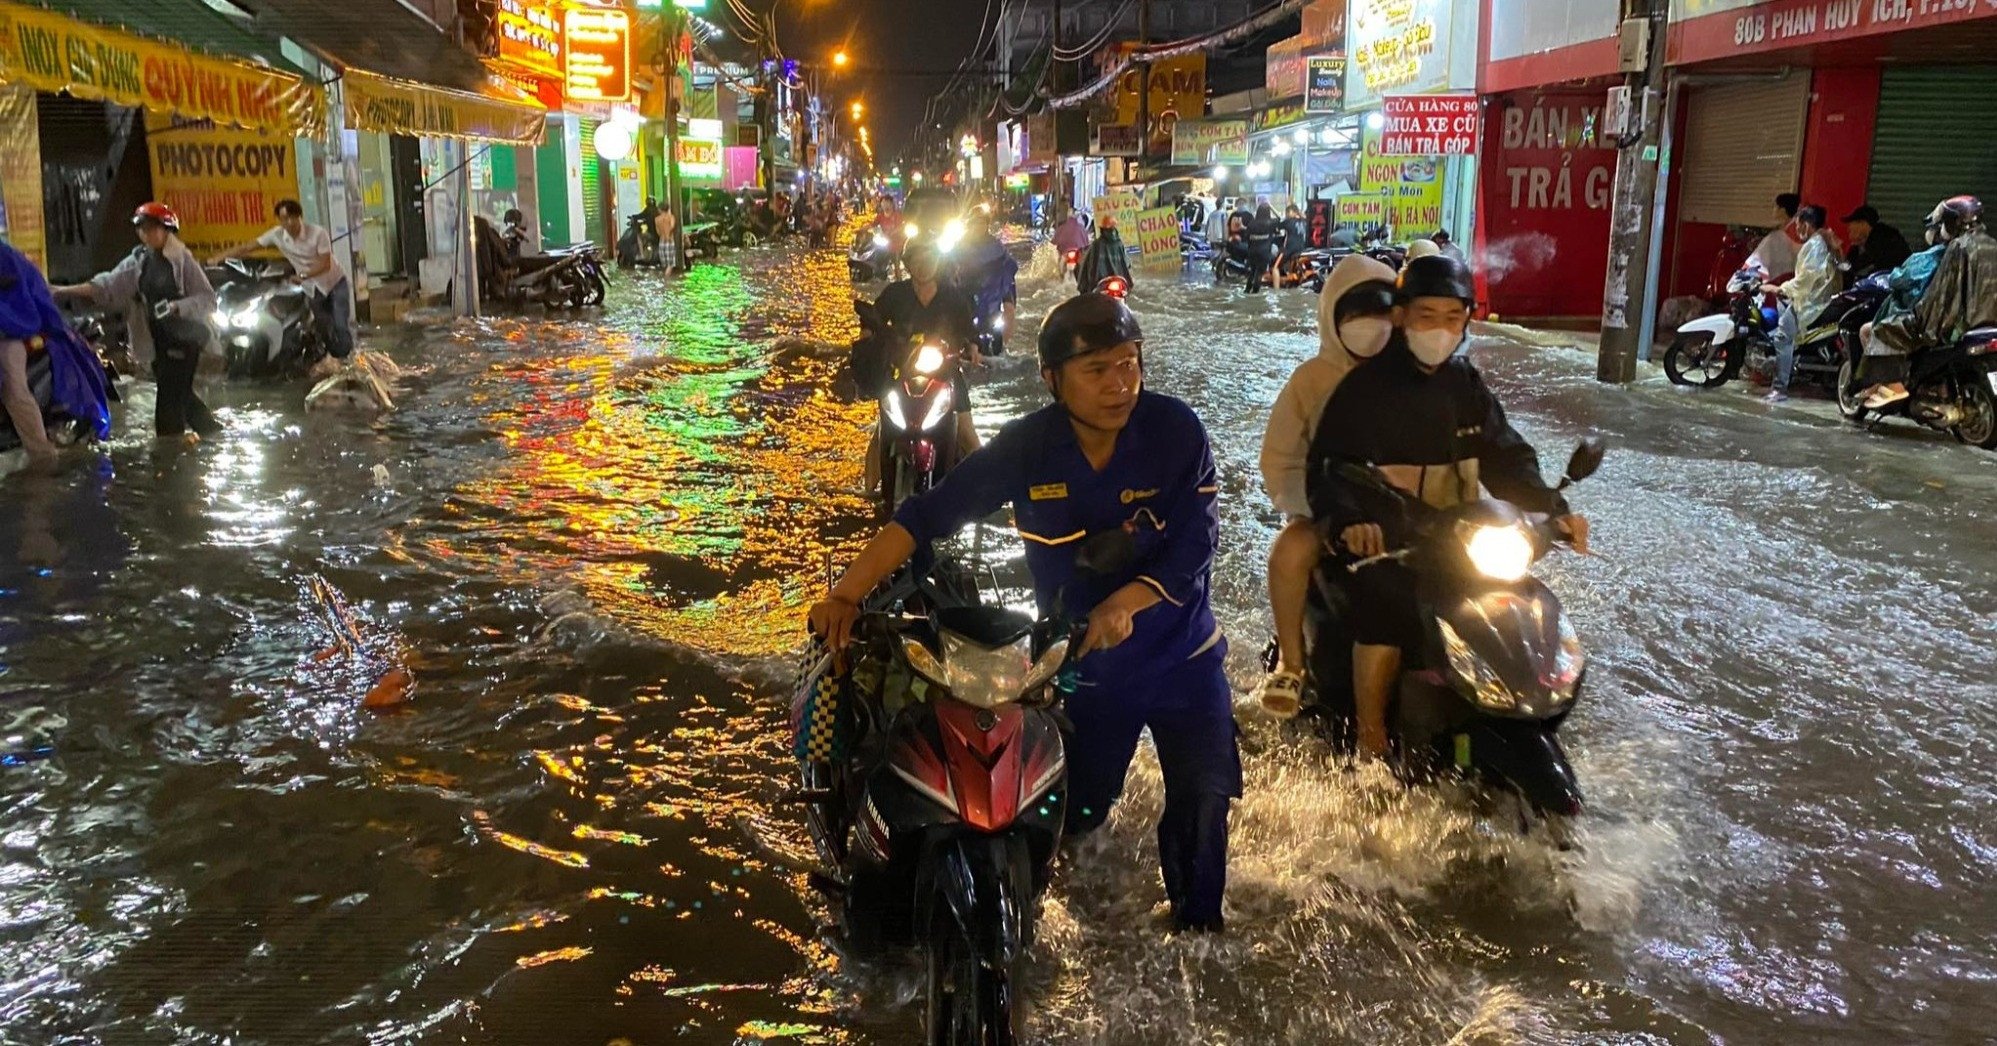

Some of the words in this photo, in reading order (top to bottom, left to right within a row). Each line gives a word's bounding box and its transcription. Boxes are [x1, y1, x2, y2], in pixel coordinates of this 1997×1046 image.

[1735, 14, 1765, 45] 80B
[1771, 11, 1816, 40] PHAN
[1310, 60, 1345, 69] Luxury
[1385, 98, 1414, 112] CỬA
[1419, 98, 1459, 112] HÀNG
[1463, 101, 1478, 112] 80
[1385, 116, 1421, 132] MUA
[1425, 116, 1448, 132] XE
[1453, 113, 1475, 132] CŨ
[1503, 96, 1569, 149] BÁN
[1386, 133, 1412, 154] BÁN
[1416, 133, 1440, 154] TRẢ
[1444, 133, 1470, 154] GÓP
[157, 142, 286, 178] PHOTOCOPY
[1506, 152, 1572, 209] TRẢ
[1584, 166, 1615, 210] G
